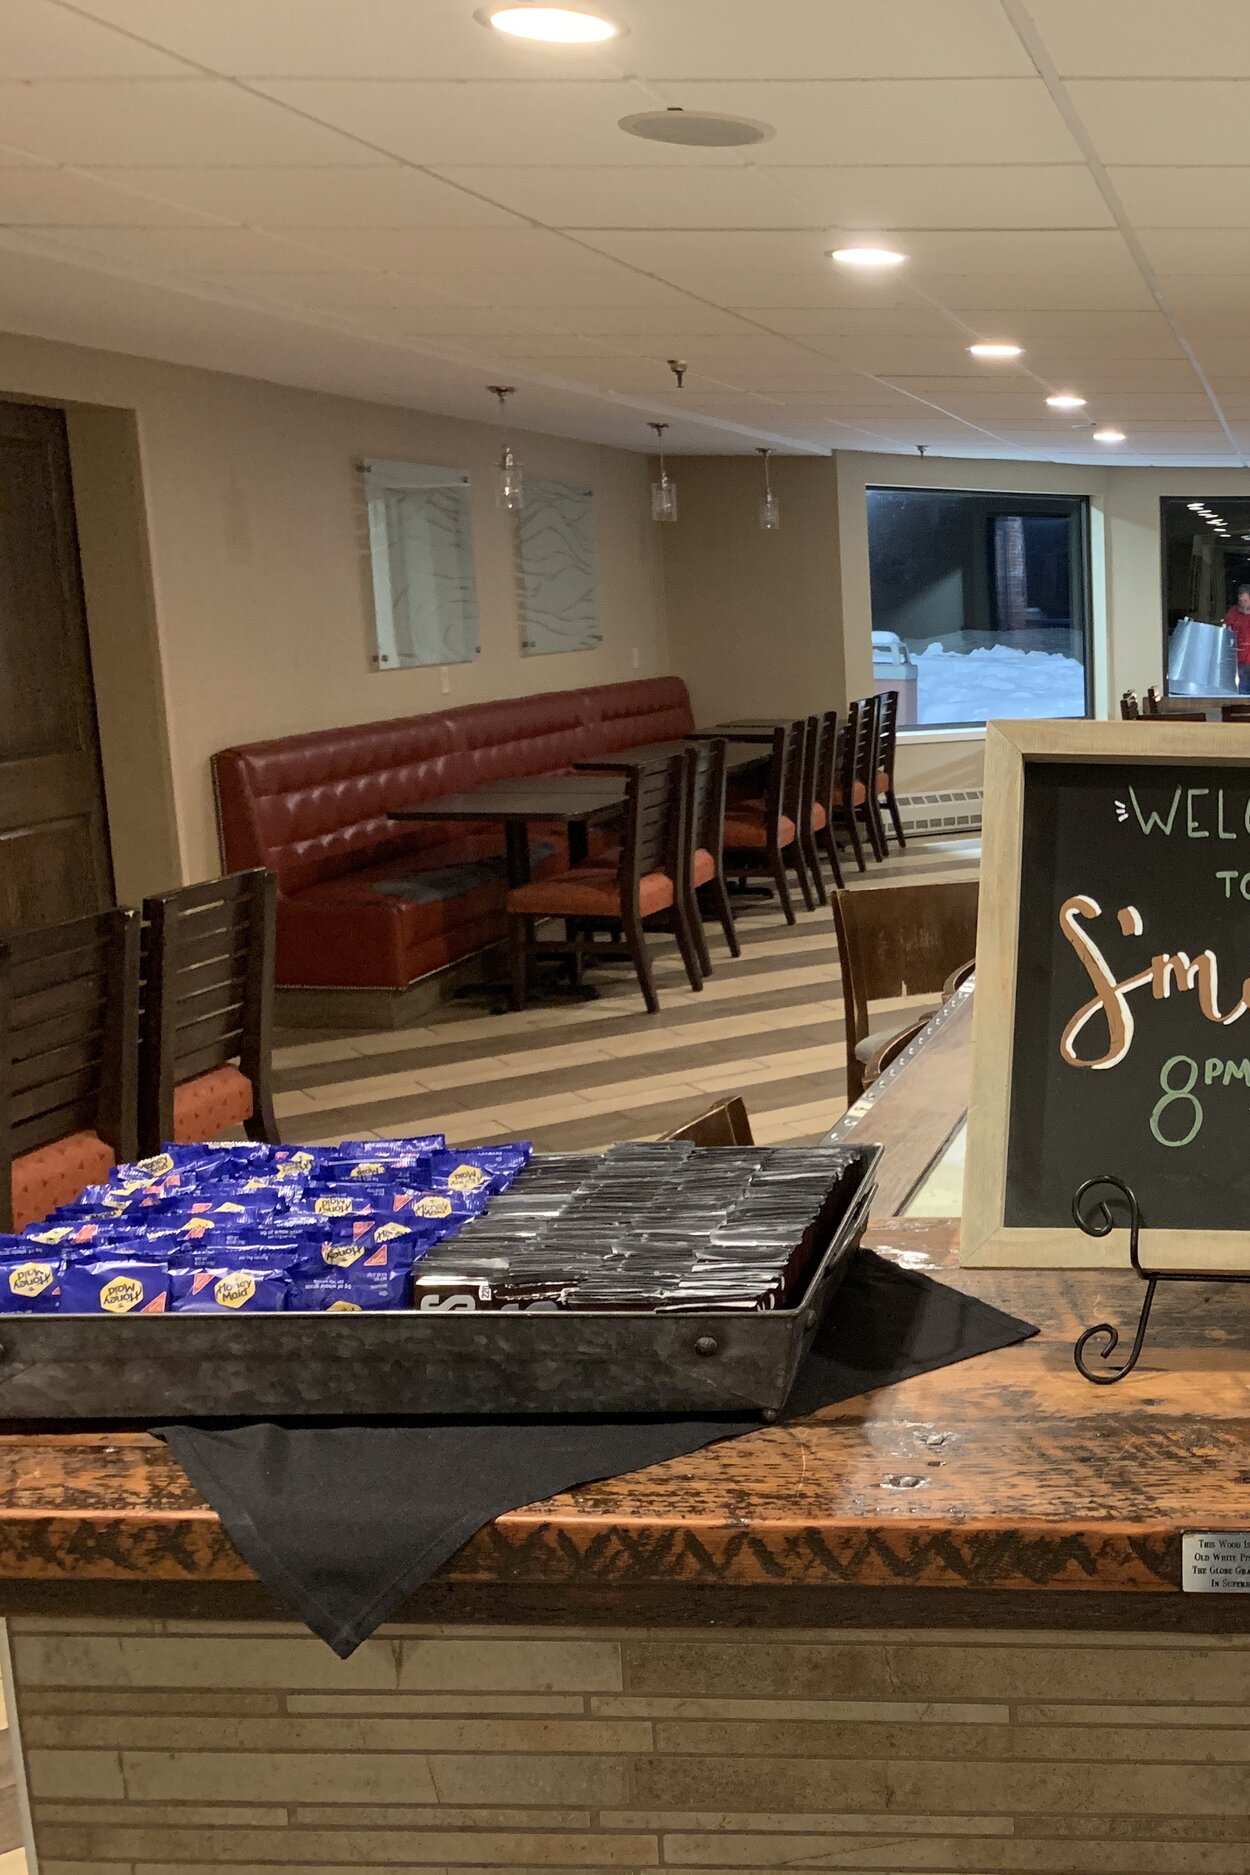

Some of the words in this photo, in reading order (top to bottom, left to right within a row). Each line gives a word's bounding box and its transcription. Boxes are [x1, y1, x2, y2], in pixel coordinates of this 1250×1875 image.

[326, 1246, 365, 1261] Honey
[17, 1269, 44, 1280] Maid
[13, 1273, 51, 1290] Honey
[216, 1279, 253, 1297] Honey
[103, 1285, 142, 1305] Honey
[108, 1283, 136, 1296] Maid
[222, 1286, 249, 1303] Maid
[1198, 1539, 1216, 1549] THIS
[1219, 1540, 1241, 1549] WOOD
[1194, 1552, 1210, 1561] OLD
[1213, 1553, 1236, 1562] WHITE
[1192, 1565, 1207, 1575] THE
[1209, 1566, 1233, 1575] GLOBE
[1211, 1579, 1220, 1588] IN
